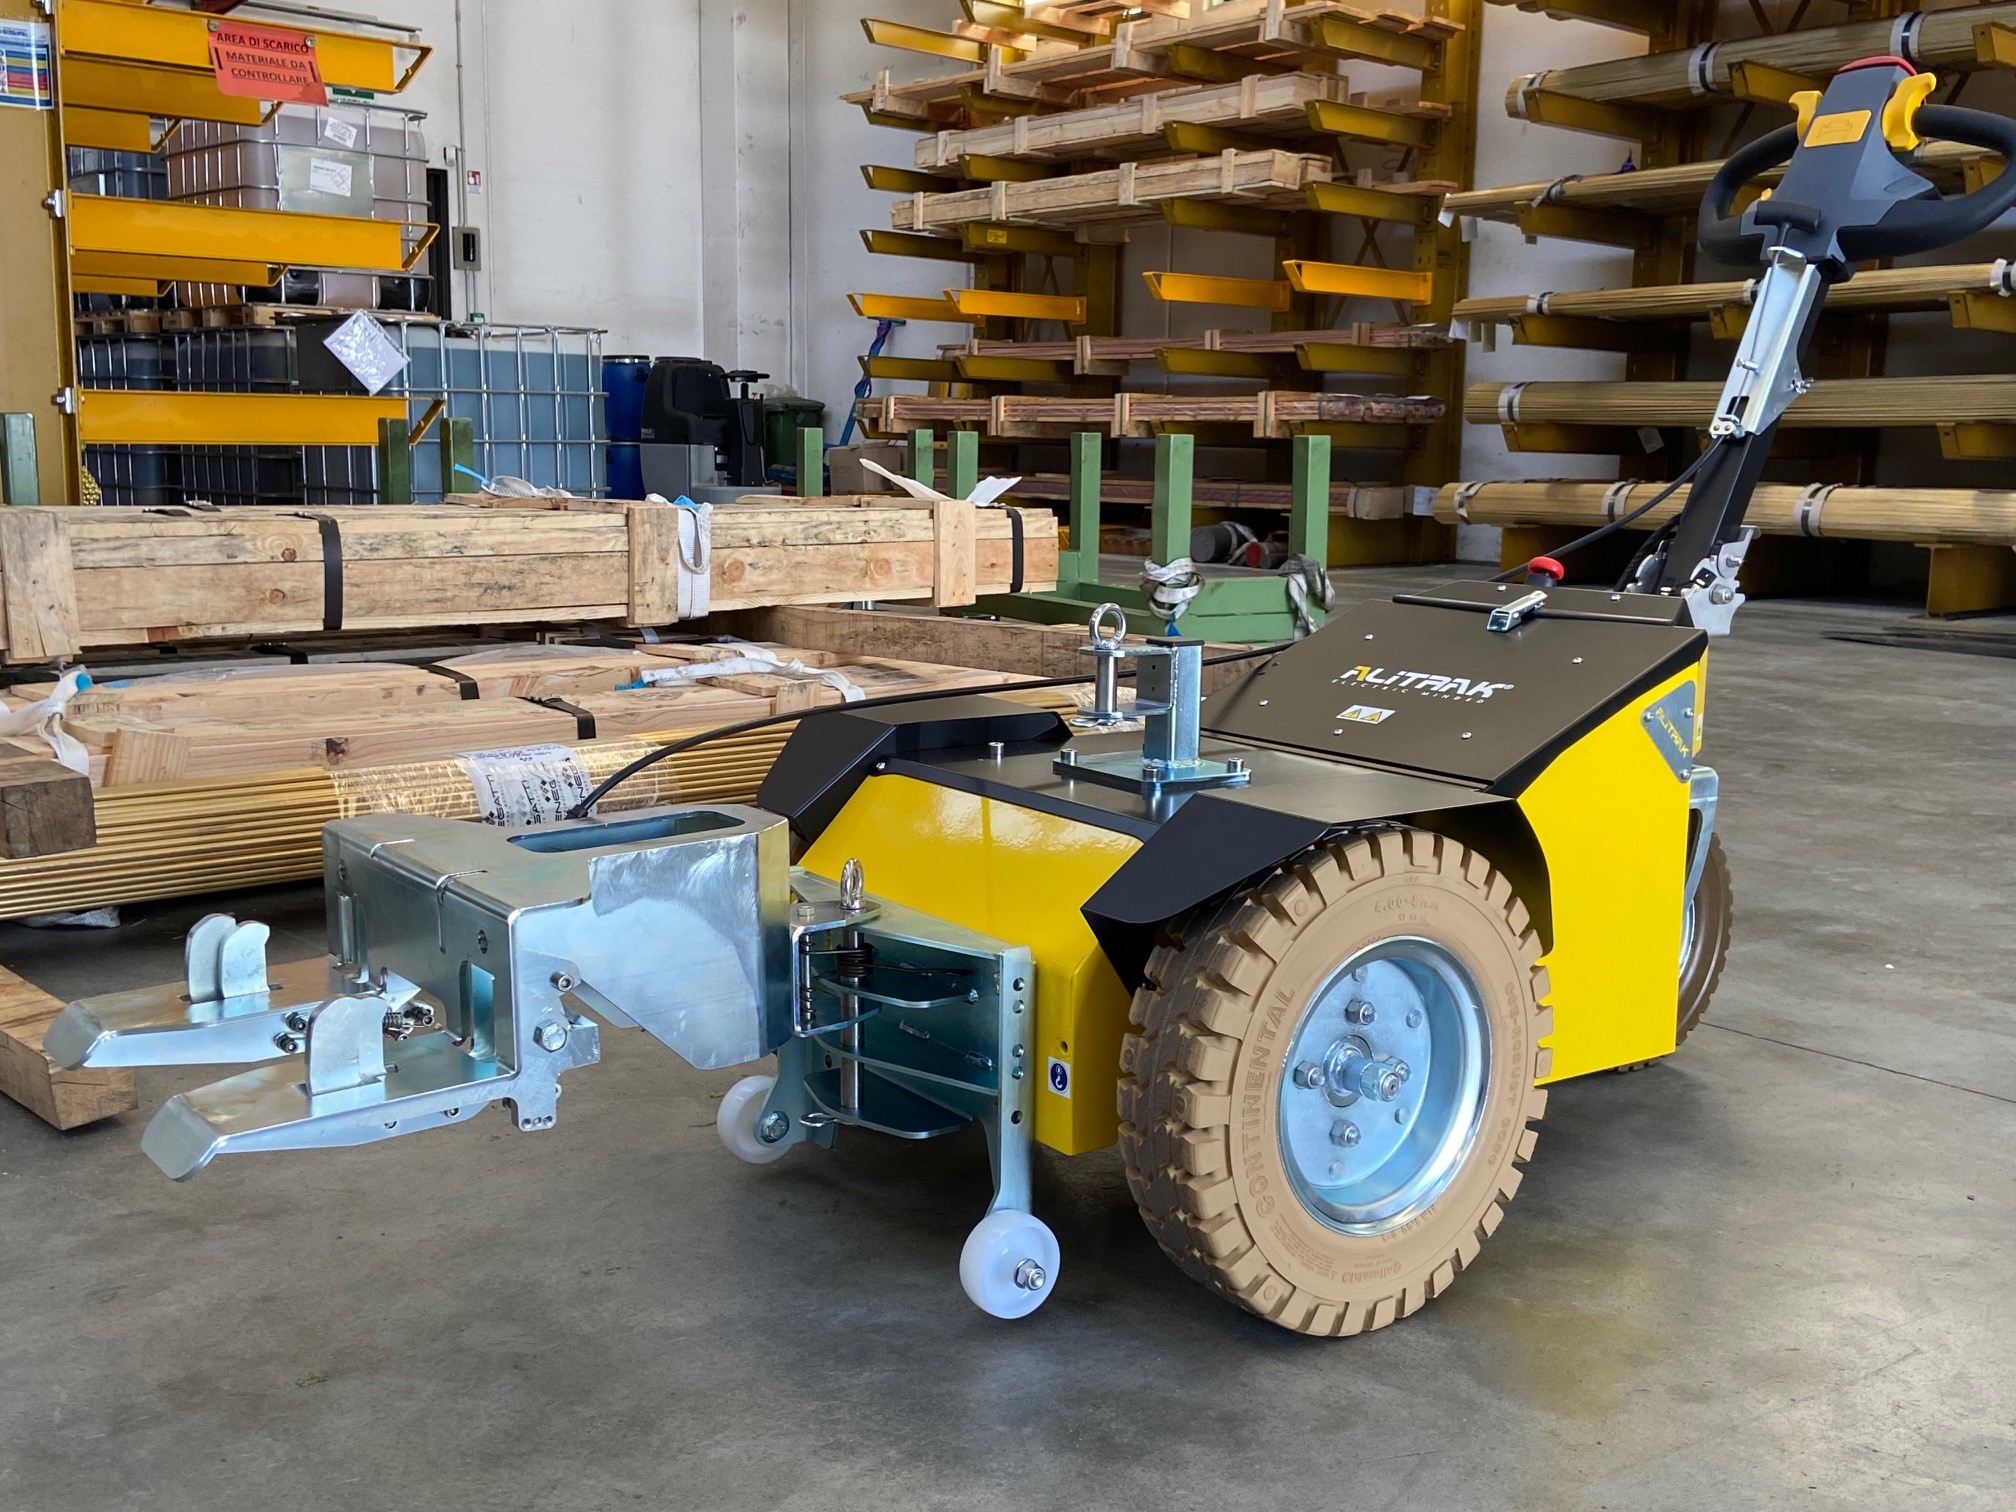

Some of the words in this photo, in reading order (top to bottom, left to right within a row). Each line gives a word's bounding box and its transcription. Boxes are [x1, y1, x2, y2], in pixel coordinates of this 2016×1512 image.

[217, 33, 246, 46] AREA
[249, 36, 260, 47] DI
[263, 39, 309, 54] SCARICO
[226, 51, 288, 68] MATERIALE
[290, 60, 307, 70] DA
[231, 68, 309, 84] CONTROLLARE
[1331, 678, 1408, 693] ELECTRIC
[1420, 691, 1485, 704] MINDED
[1241, 986, 1296, 1219] CONTINENTAL
